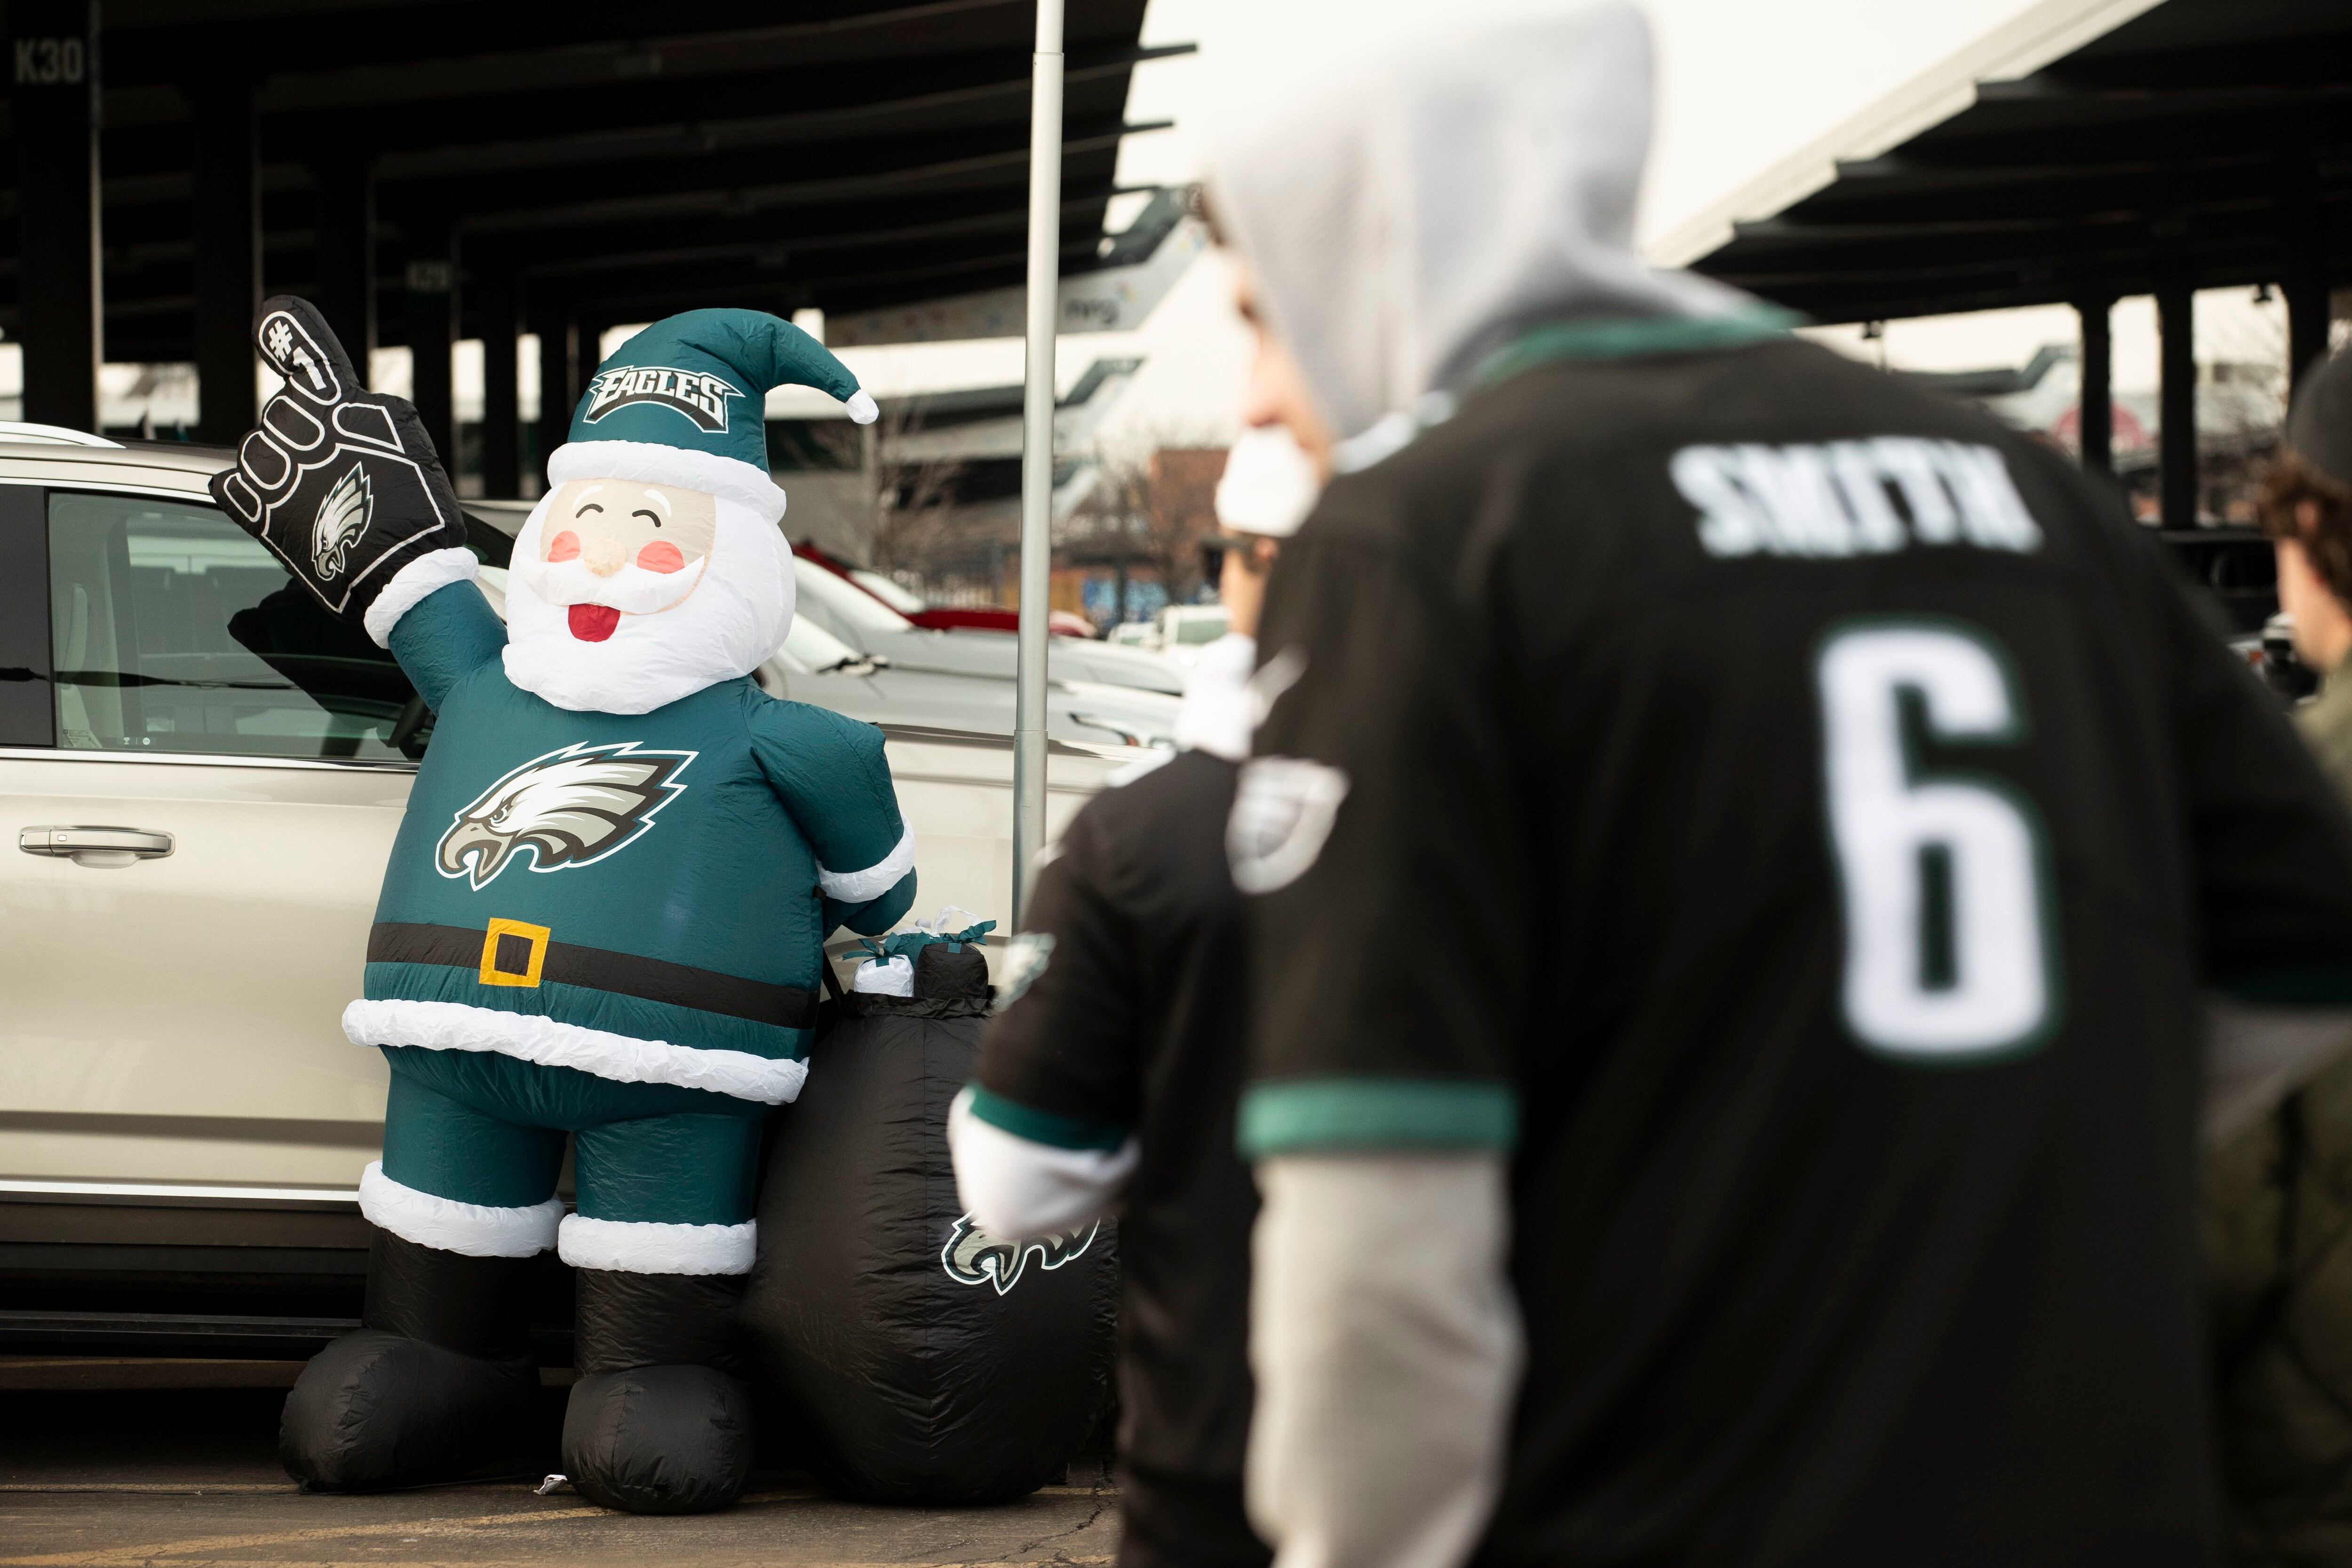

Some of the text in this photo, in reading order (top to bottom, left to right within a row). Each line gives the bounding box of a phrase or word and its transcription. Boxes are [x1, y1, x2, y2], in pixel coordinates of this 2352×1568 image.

[16, 40, 83, 82] K30
[586, 368, 735, 429] EAGLES
[1668, 435, 2043, 558] SMITH
[1816, 624, 2058, 1059] 6
